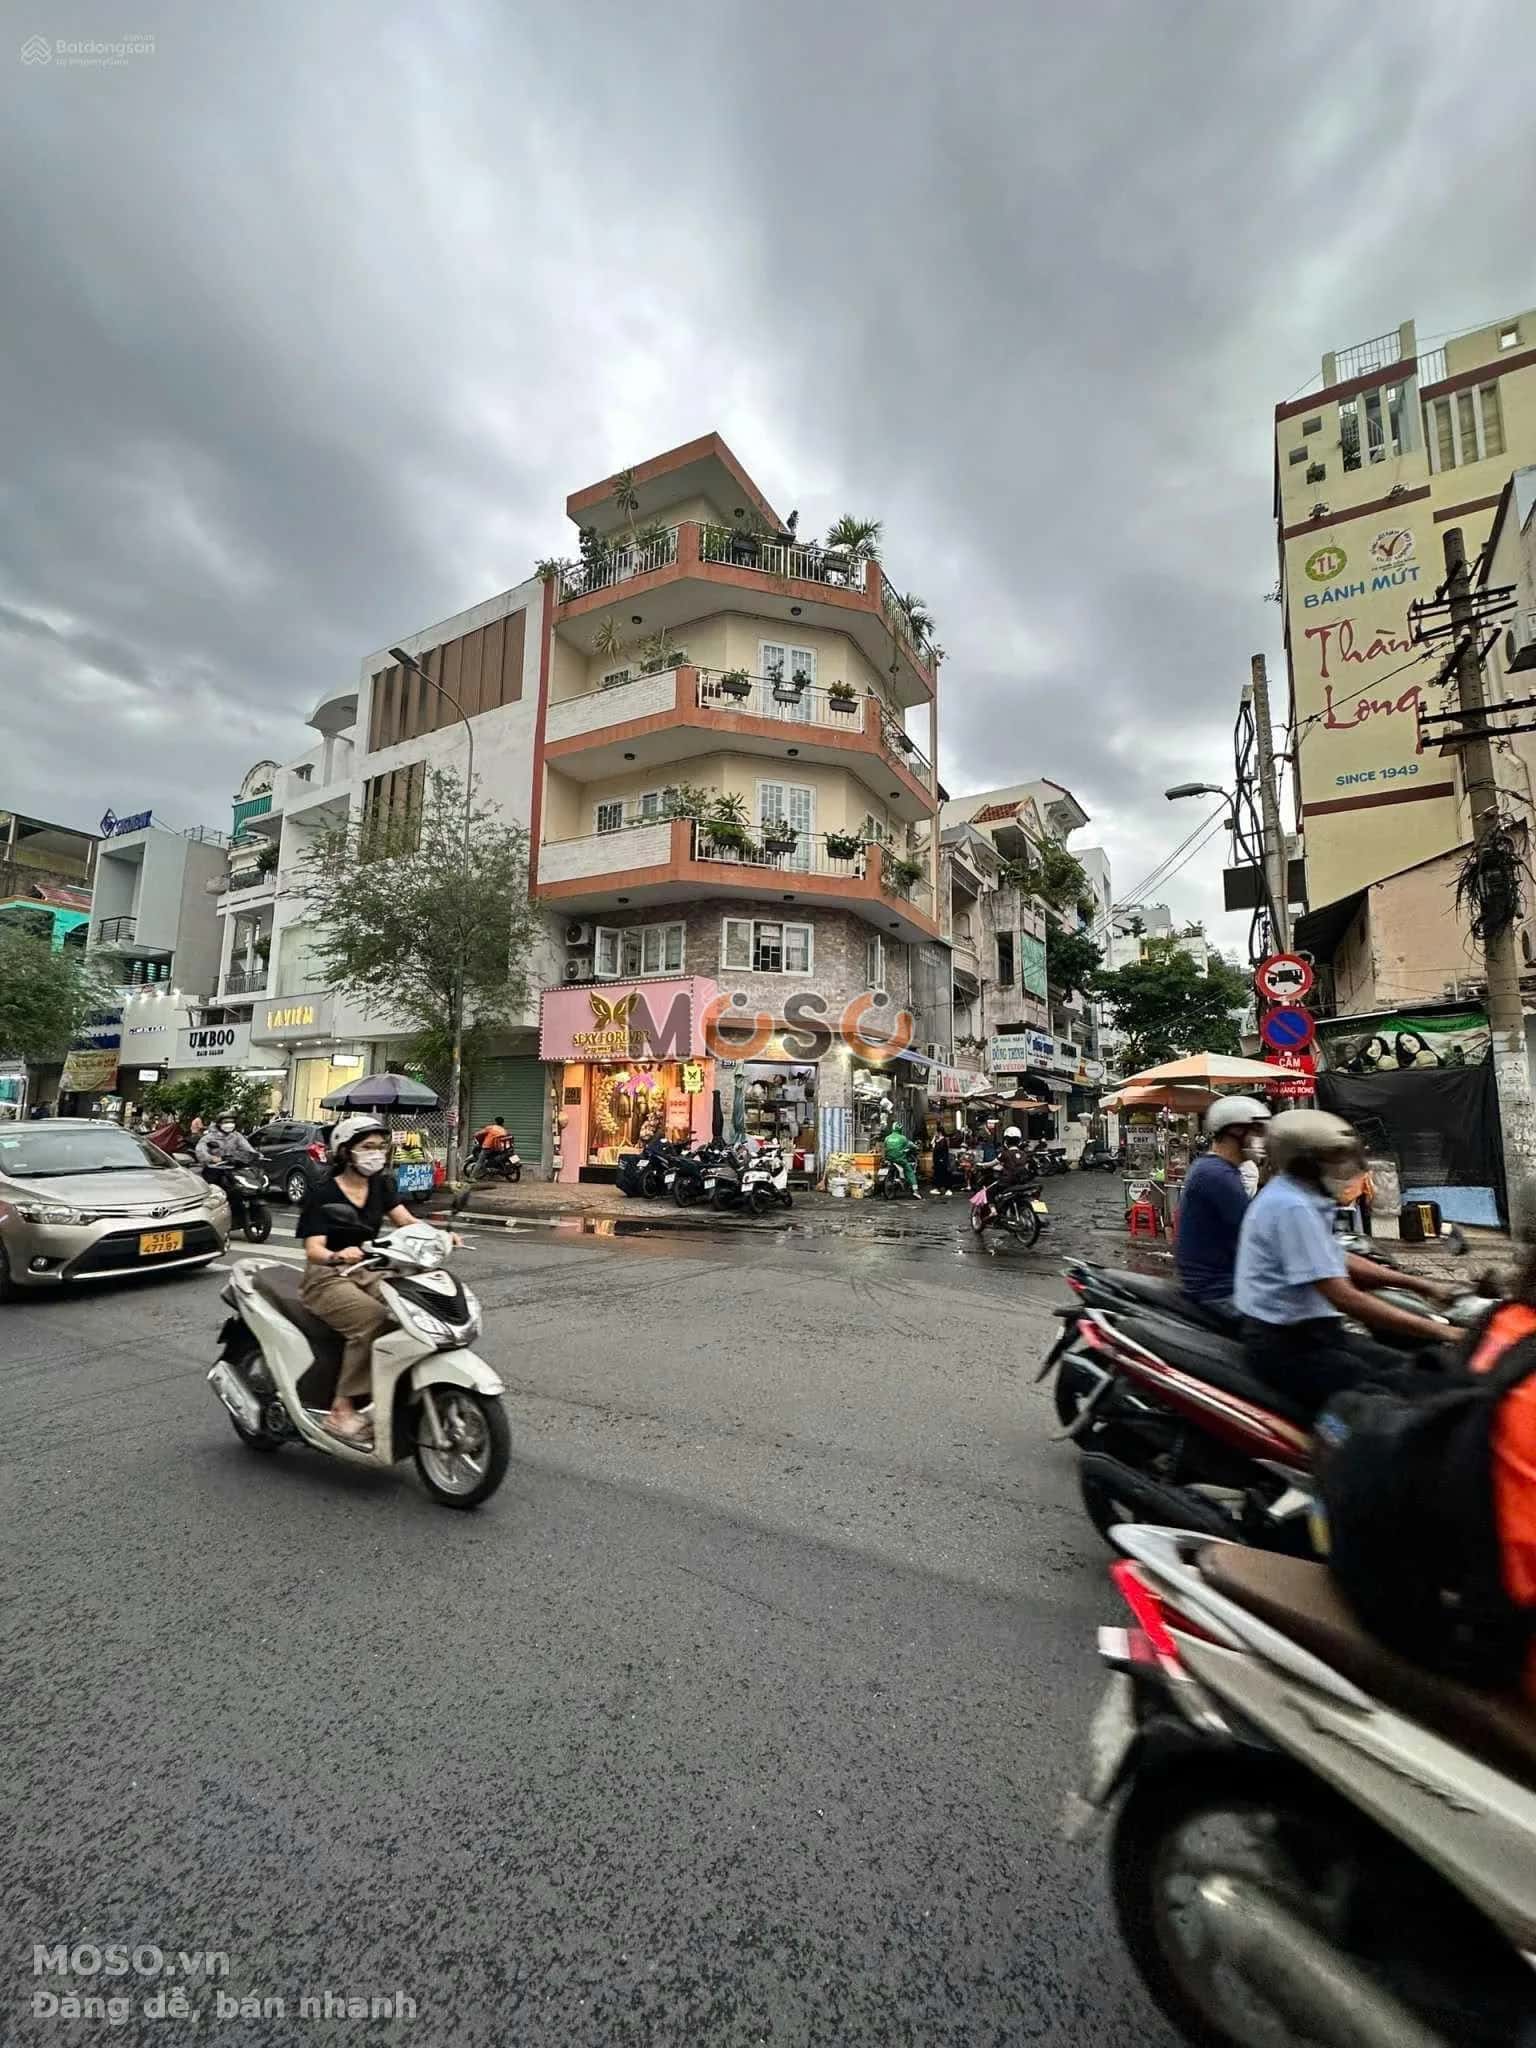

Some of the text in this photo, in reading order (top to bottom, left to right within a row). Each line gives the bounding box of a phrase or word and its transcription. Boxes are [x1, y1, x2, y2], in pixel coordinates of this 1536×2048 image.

[1317, 556, 1336, 573] TL
[1303, 581, 1365, 608] BÁNH
[1304, 617, 1433, 678] Thàn
[1323, 685, 1424, 755] Long
[1335, 764, 1419, 786] SINCE 1949
[189, 1029, 235, 1049] UMBOO
[572, 1033, 601, 1048] SEXY
